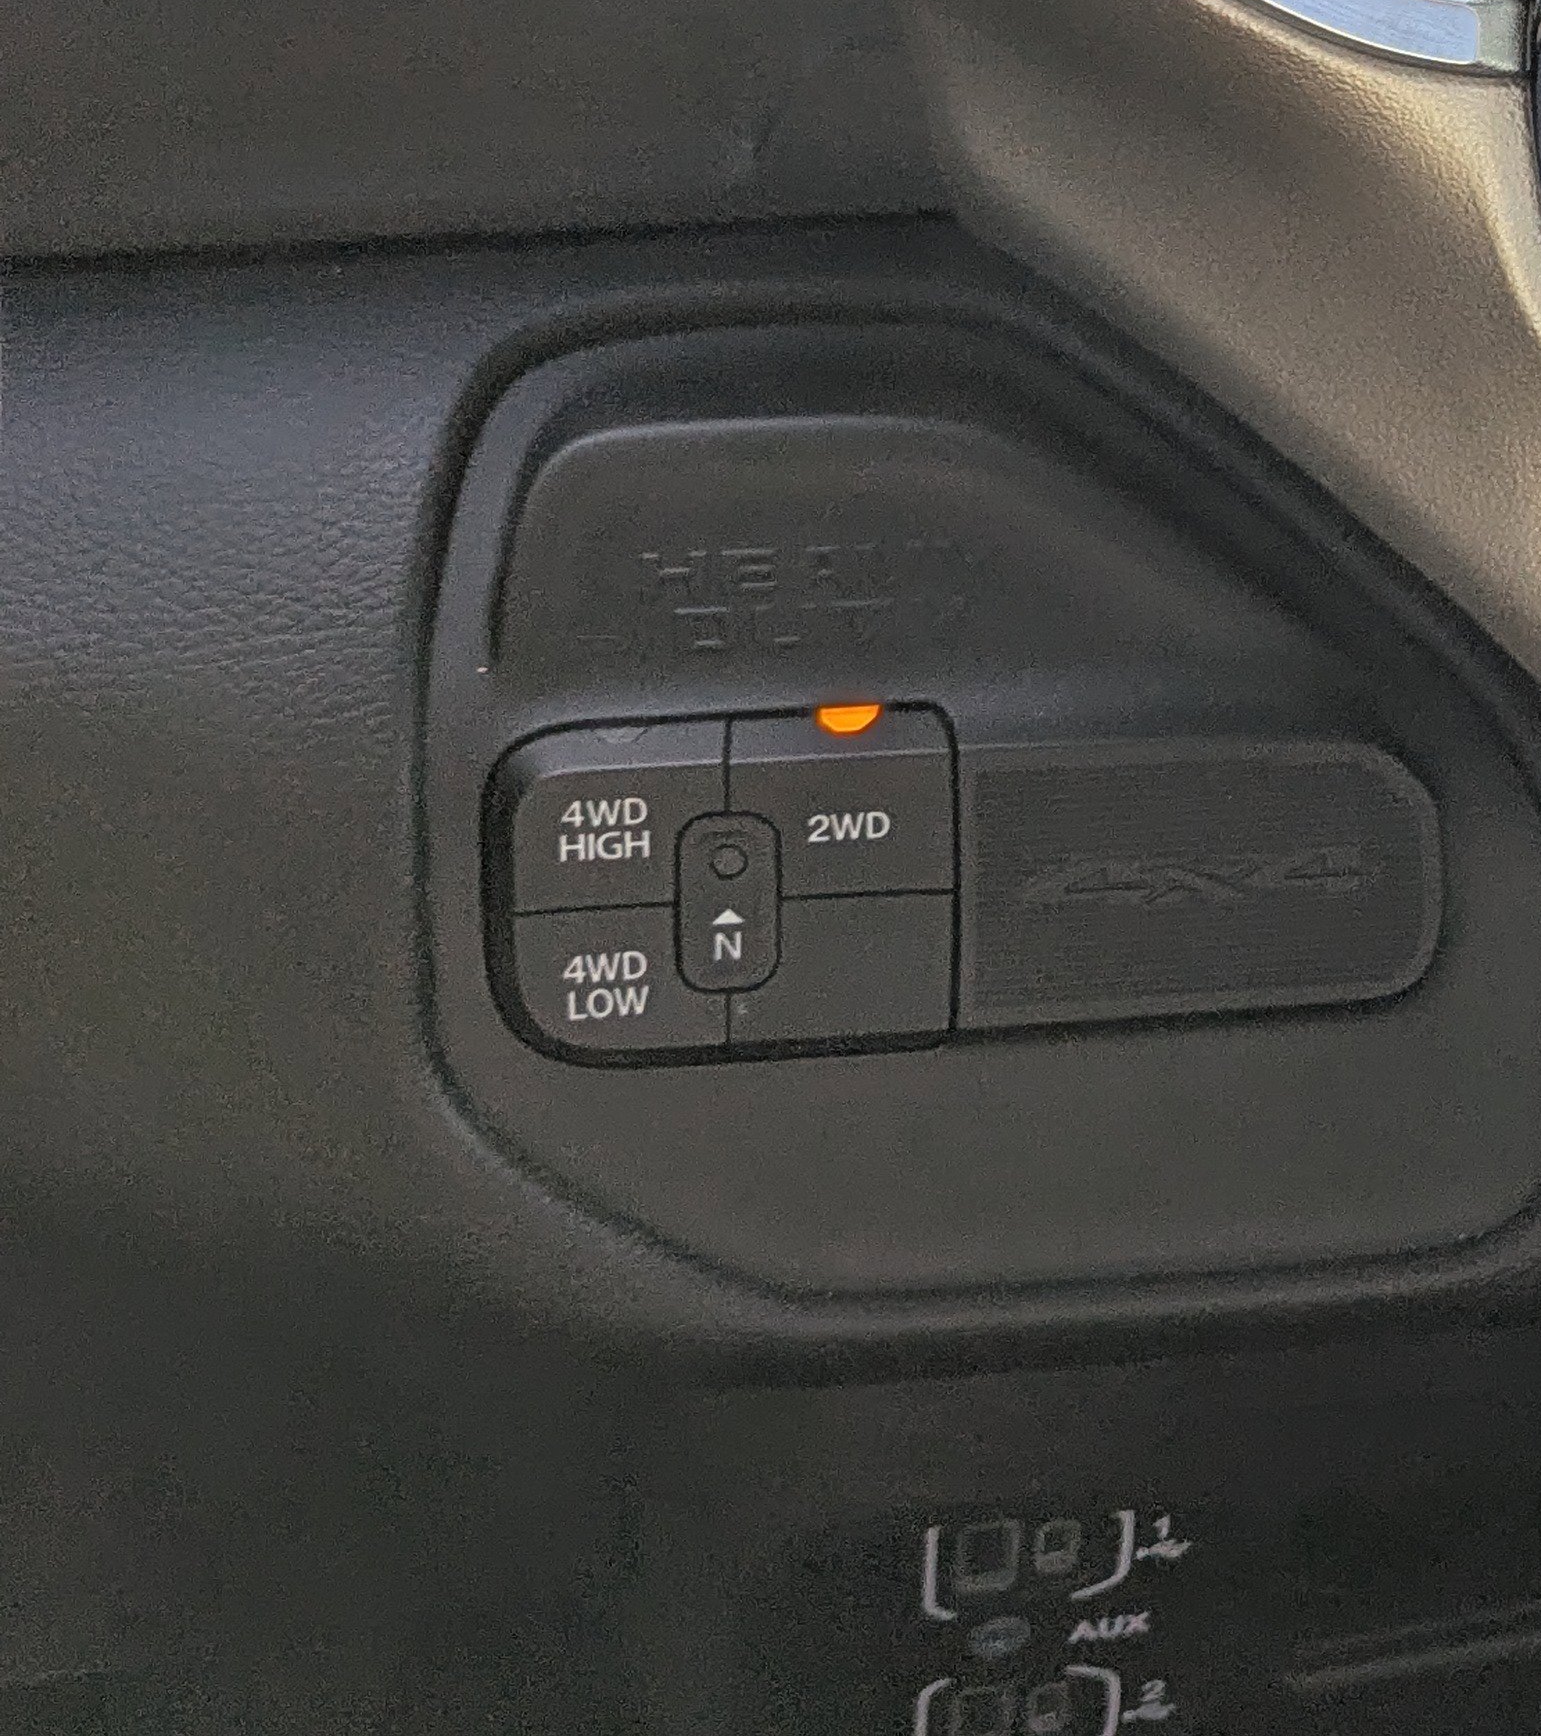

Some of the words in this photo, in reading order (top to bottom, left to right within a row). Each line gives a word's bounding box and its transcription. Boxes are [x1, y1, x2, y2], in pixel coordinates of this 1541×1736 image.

[560, 797, 649, 828] 4WD
[806, 810, 892, 844] 2WD
[559, 829, 651, 864] HIGH
[713, 931, 742, 961] N
[563, 950, 649, 983] 4WD
[567, 984, 650, 1022] LOW
[1068, 1612, 1151, 1644] AUX
